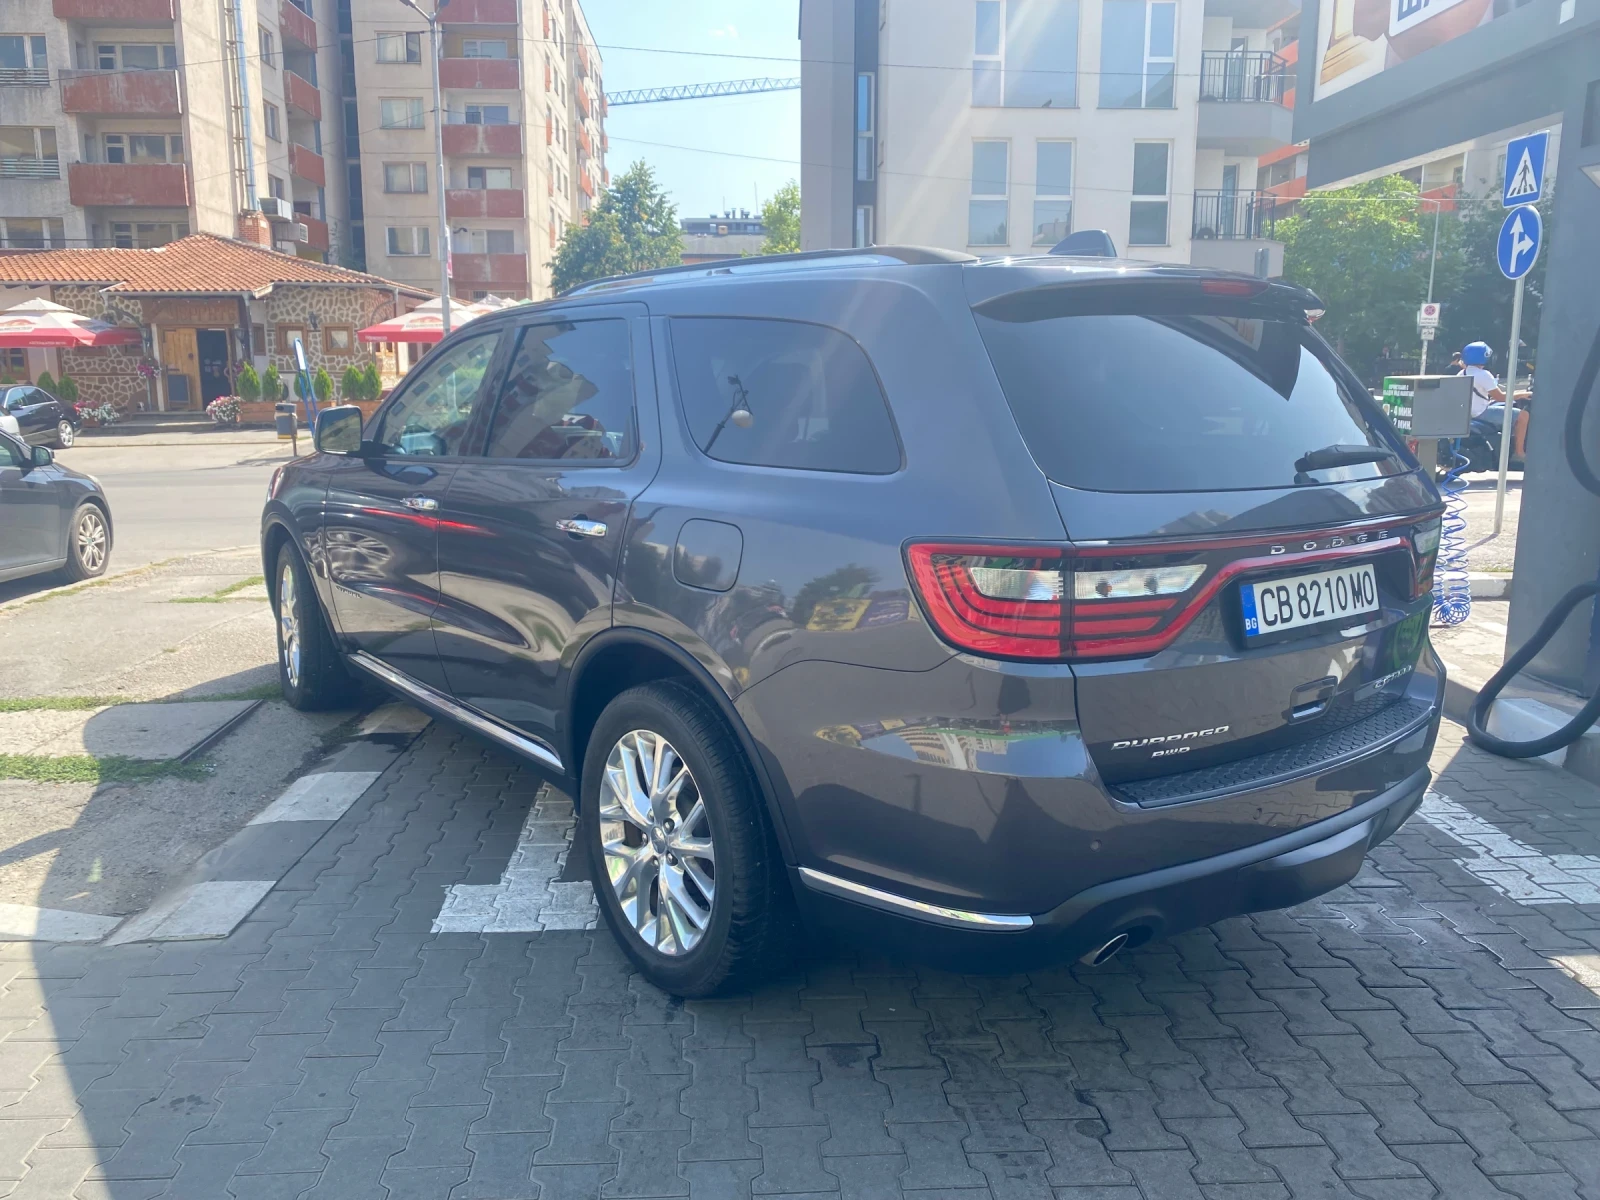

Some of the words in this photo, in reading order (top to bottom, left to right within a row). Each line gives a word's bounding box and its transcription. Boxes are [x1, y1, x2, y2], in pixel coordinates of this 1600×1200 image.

[1393, 405, 1398, 416] 4
[1270, 530, 1389, 555] DODGE
[1260, 585, 1294, 627] CB
[1296, 575, 1348, 619] 8210
[1349, 570, 1375, 610] MO
[1245, 618, 1258, 630] BG
[1111, 725, 1230, 751] DURANGO
[1150, 746, 1191, 758] AWD
